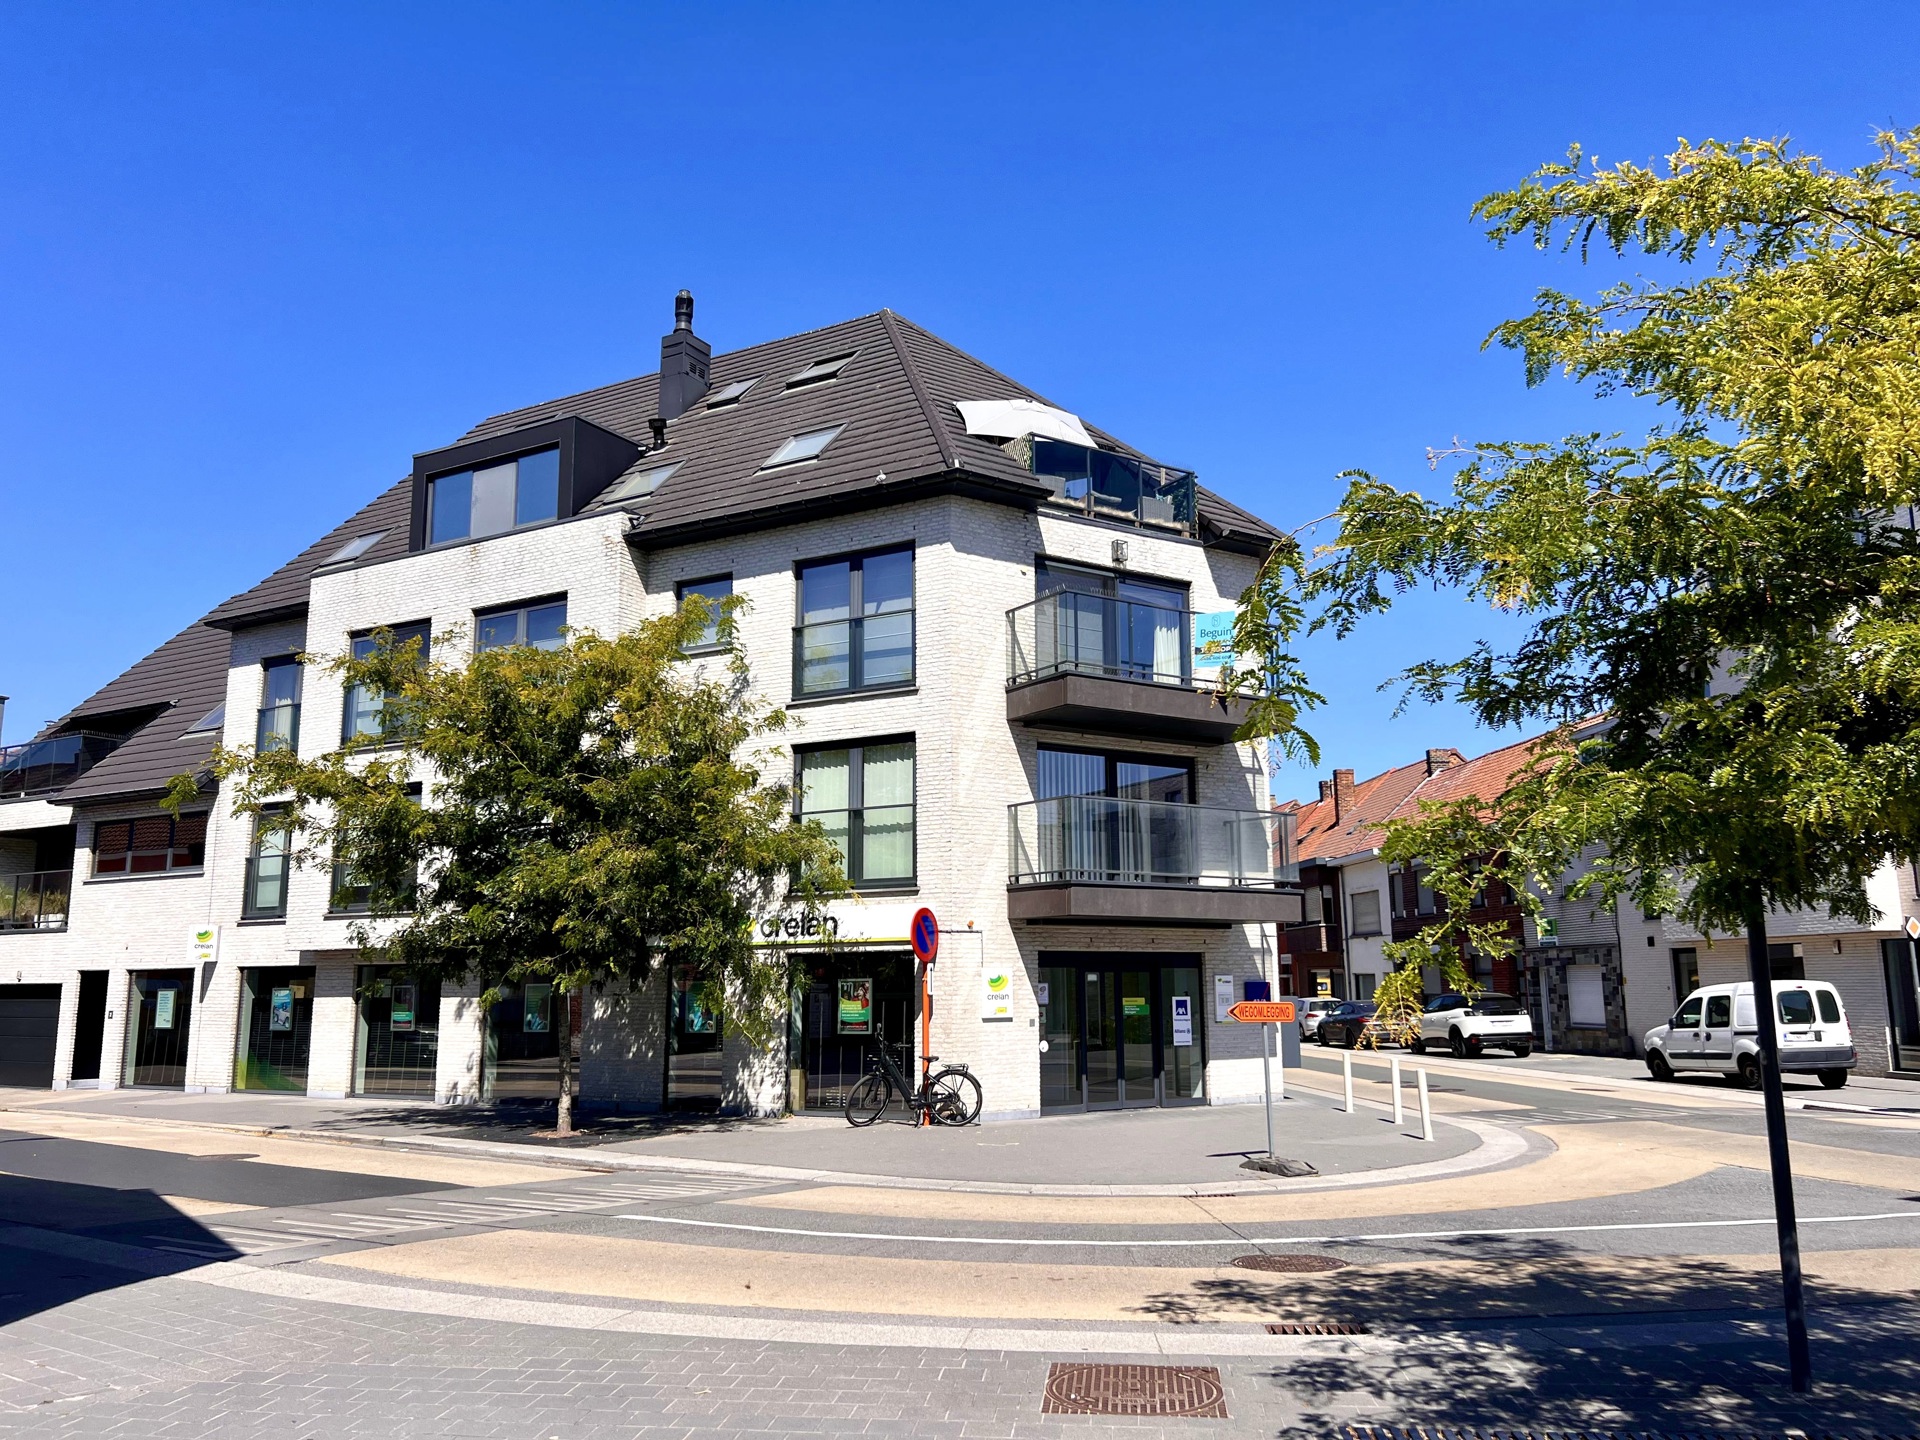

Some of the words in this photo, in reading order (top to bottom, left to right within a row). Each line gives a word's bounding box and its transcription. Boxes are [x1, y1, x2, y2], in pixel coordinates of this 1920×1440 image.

[1200, 627, 1232, 639] Beguin
[760, 911, 838, 937] crelan
[1239, 1006, 1290, 1018] WEGOMLEGGING
